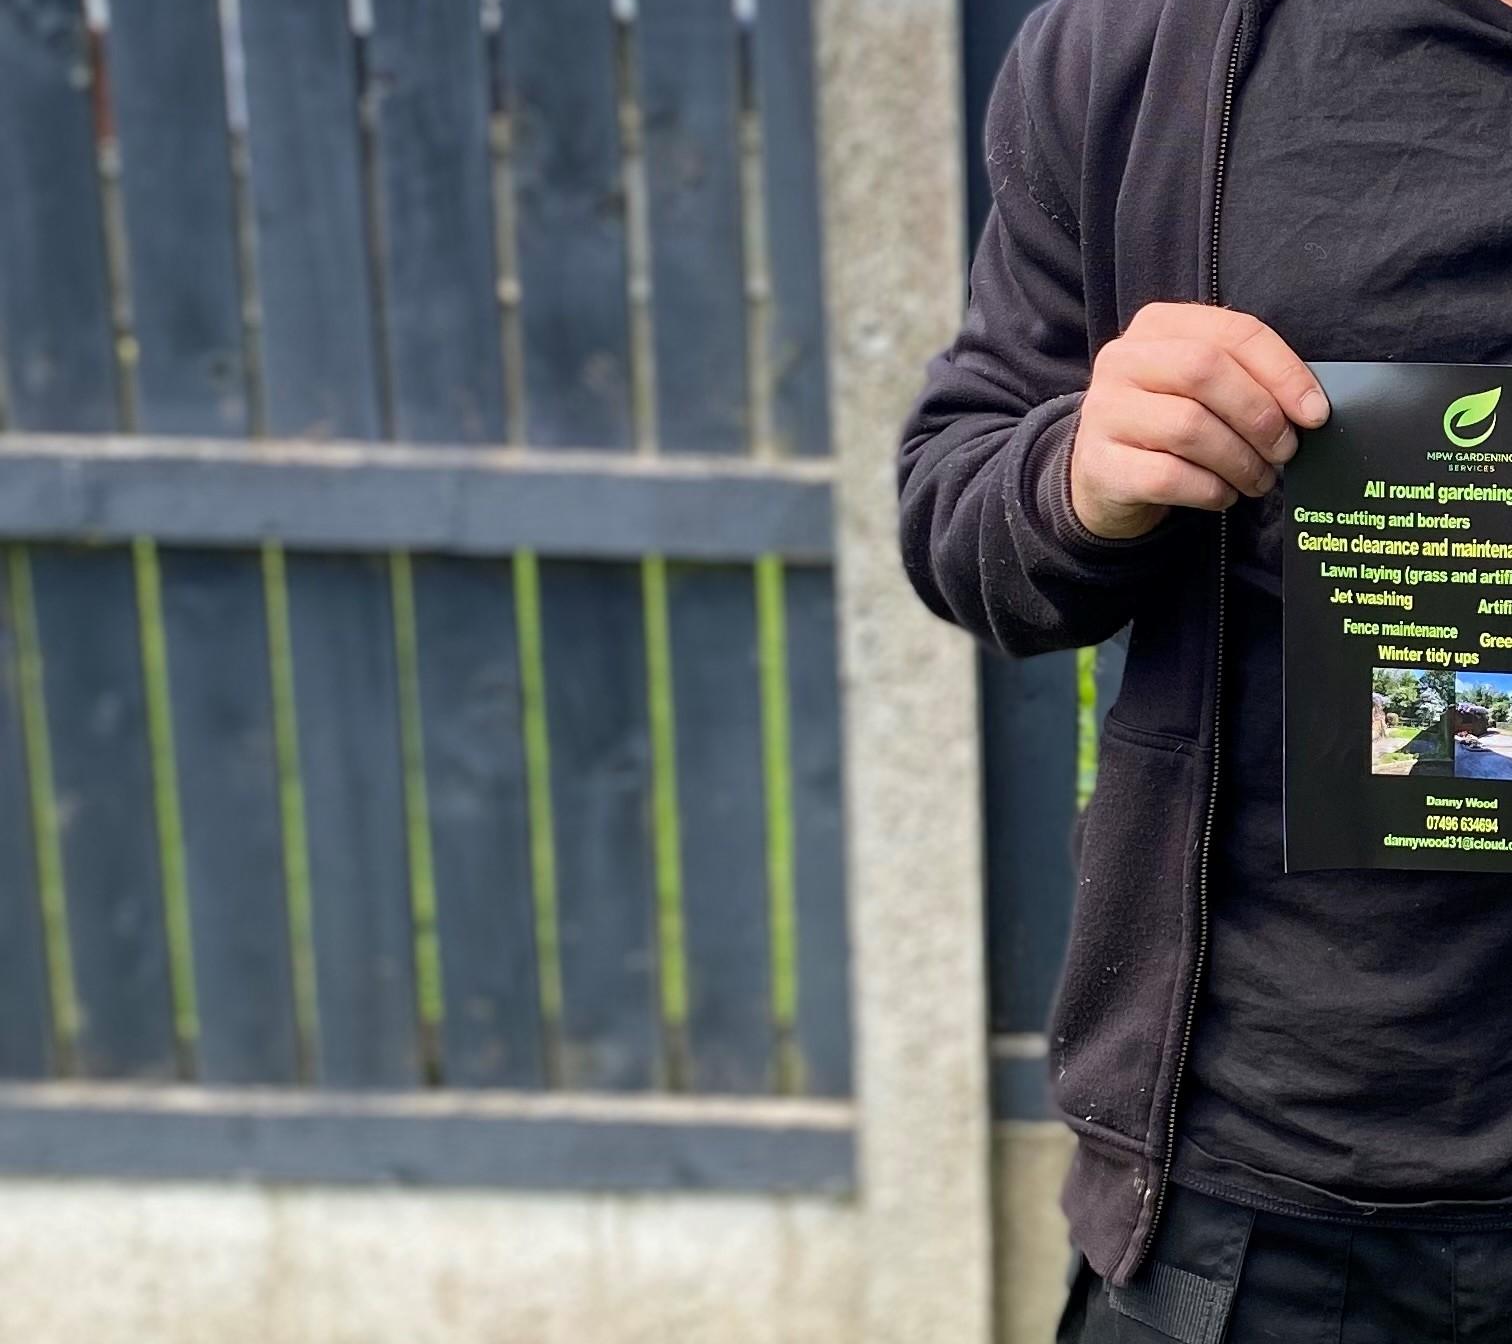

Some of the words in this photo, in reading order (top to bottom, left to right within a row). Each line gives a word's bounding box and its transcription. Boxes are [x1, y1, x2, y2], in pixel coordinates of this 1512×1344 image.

[1426, 451, 1453, 461] MPW
[1448, 464, 1496, 472] SERVICES
[1364, 481, 1385, 497] All
[1390, 483, 1434, 499] round
[1294, 507, 1333, 523] Grass
[1337, 511, 1385, 529] cutting
[1389, 512, 1414, 527] and
[1418, 513, 1470, 529] borders
[1298, 532, 1347, 552] Garden
[1351, 535, 1419, 555] clearance
[1422, 538, 1448, 556] and
[1321, 562, 1357, 578] Lawn
[1361, 564, 1401, 584] laying
[1405, 566, 1448, 585] (grass
[1451, 569, 1476, 583] and
[1330, 588, 1353, 603] Jet
[1356, 591, 1413, 610] washing
[1344, 619, 1379, 634] Fence
[1382, 621, 1458, 638] maintenance
[1378, 645, 1423, 661] Winter
[1426, 648, 1452, 666] tidy
[1455, 653, 1479, 667] ups
[1427, 796, 1463, 809] Danny
[1465, 798, 1497, 808] Wood
[1427, 816, 1458, 831] 07496
